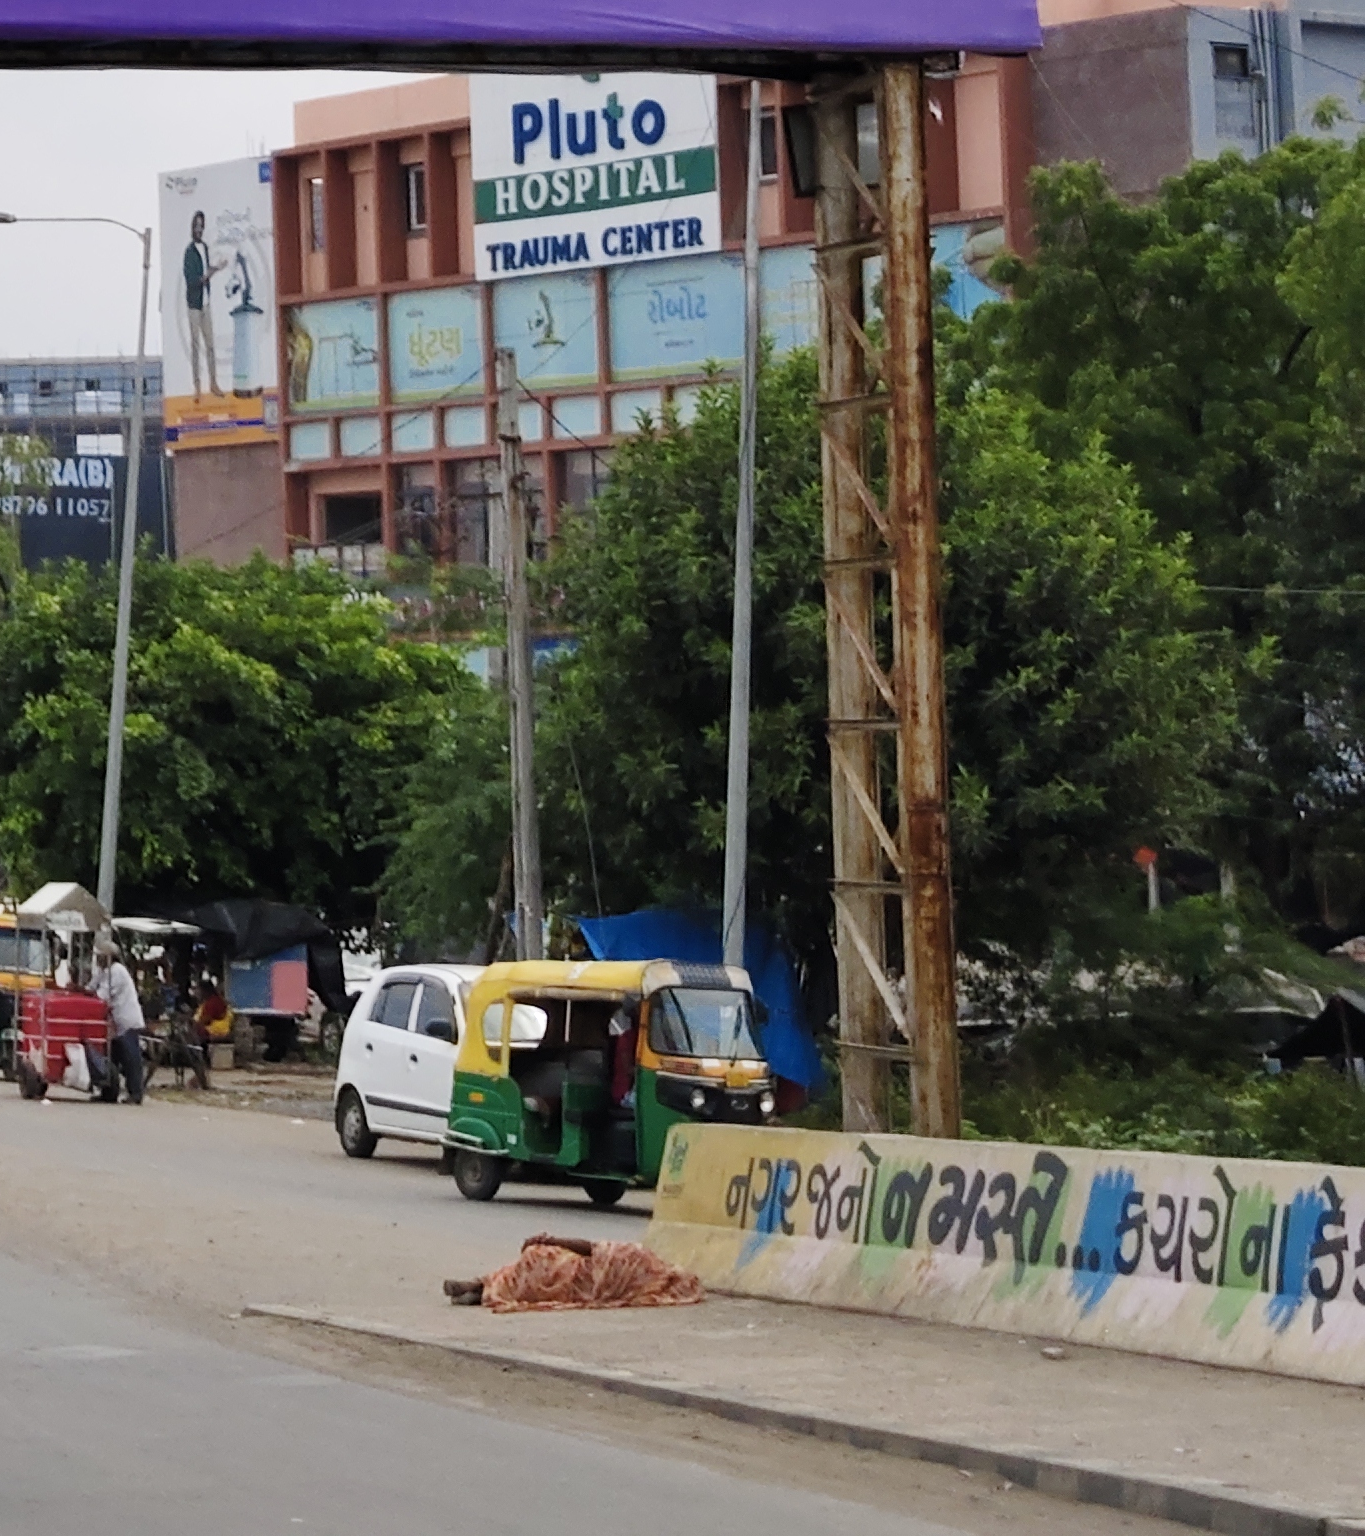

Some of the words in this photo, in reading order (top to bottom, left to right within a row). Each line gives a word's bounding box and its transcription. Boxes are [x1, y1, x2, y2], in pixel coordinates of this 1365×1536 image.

[512, 92, 666, 165] Pluto
[495, 155, 686, 215] HOSPITAL
[486, 232, 590, 272] TRAUMA
[602, 217, 704, 257] CENTER
